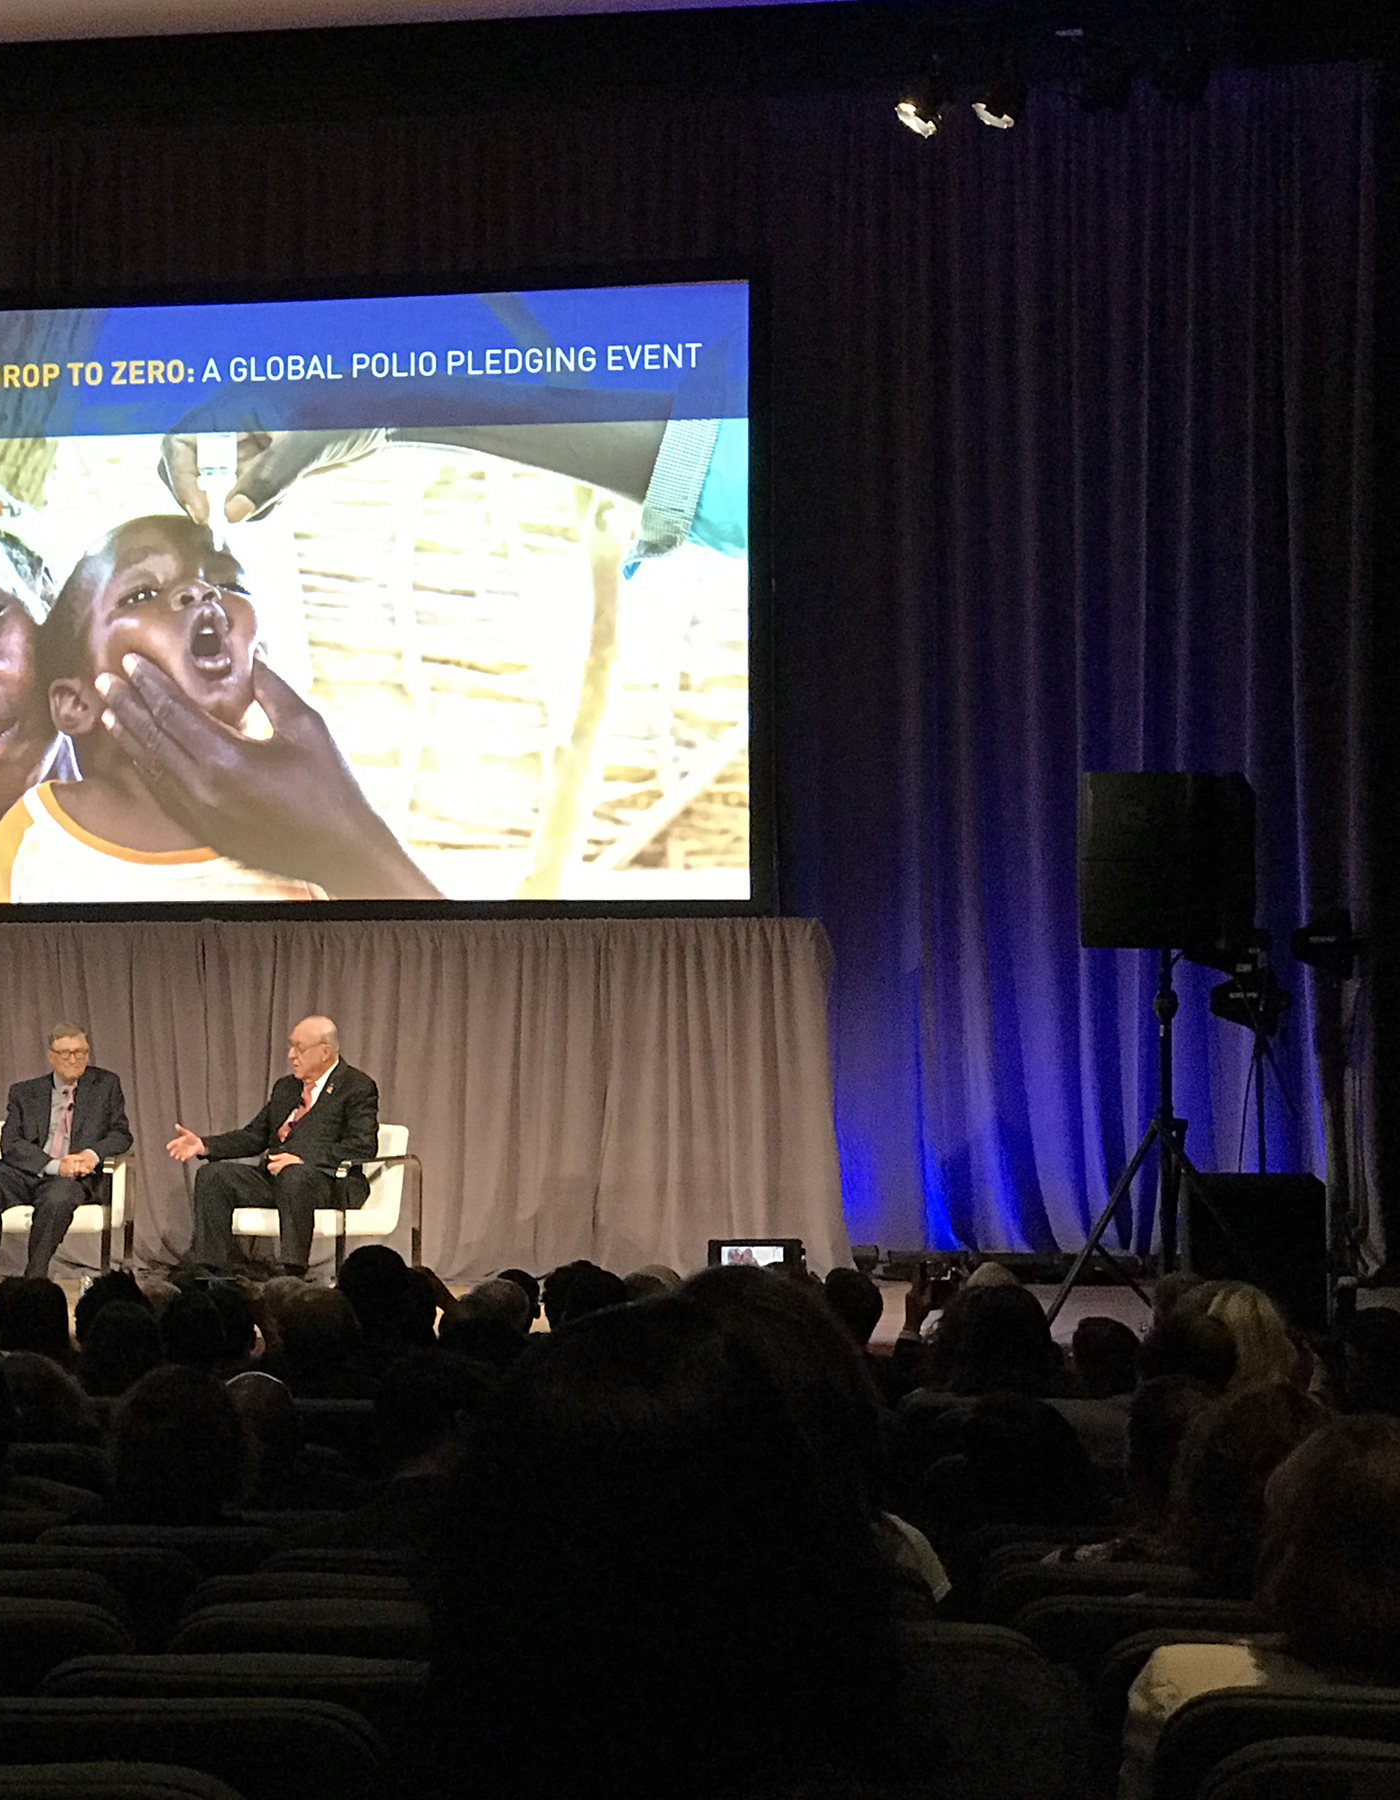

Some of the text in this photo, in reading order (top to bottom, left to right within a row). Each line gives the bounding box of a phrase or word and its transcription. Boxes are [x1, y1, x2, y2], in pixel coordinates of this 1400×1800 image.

[67, 361, 103, 387] TO
[110, 359, 195, 385] ZERO:
[202, 358, 222, 382] A
[229, 354, 342, 382] GLOBAL
[352, 351, 437, 379] POLIO
[447, 346, 597, 375] PLEDGING
[607, 343, 703, 371] EVENT
